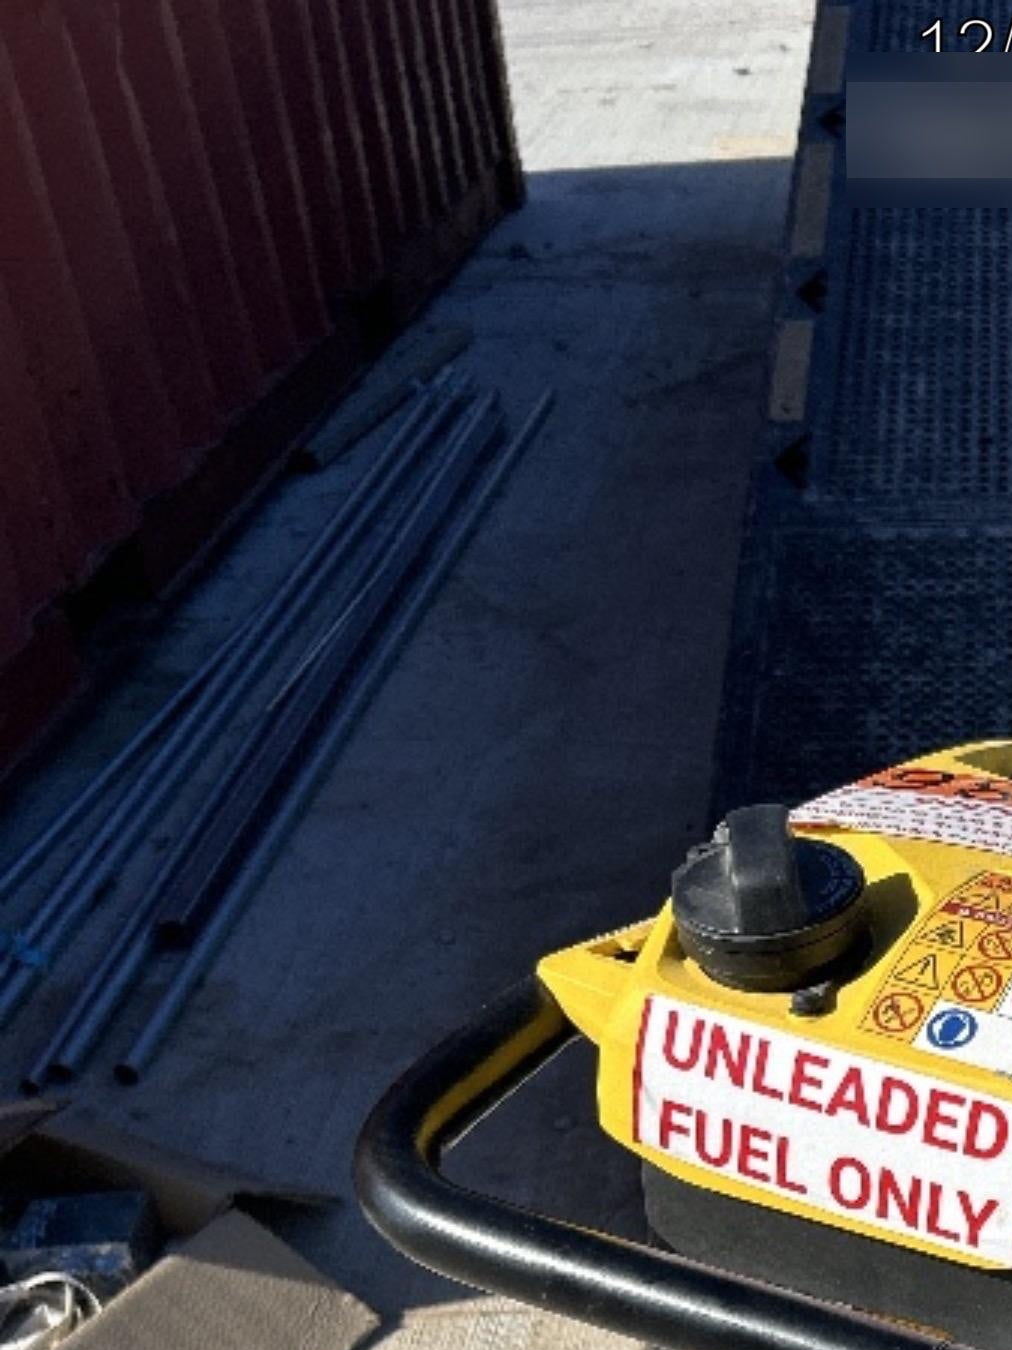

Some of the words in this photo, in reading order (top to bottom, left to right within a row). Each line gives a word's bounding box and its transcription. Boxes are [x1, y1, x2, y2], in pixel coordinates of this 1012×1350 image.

[662, 1009, 1009, 1160] UNLEADED
[659, 1098, 808, 1195] FUEL
[828, 1156, 1000, 1248] ONLY
